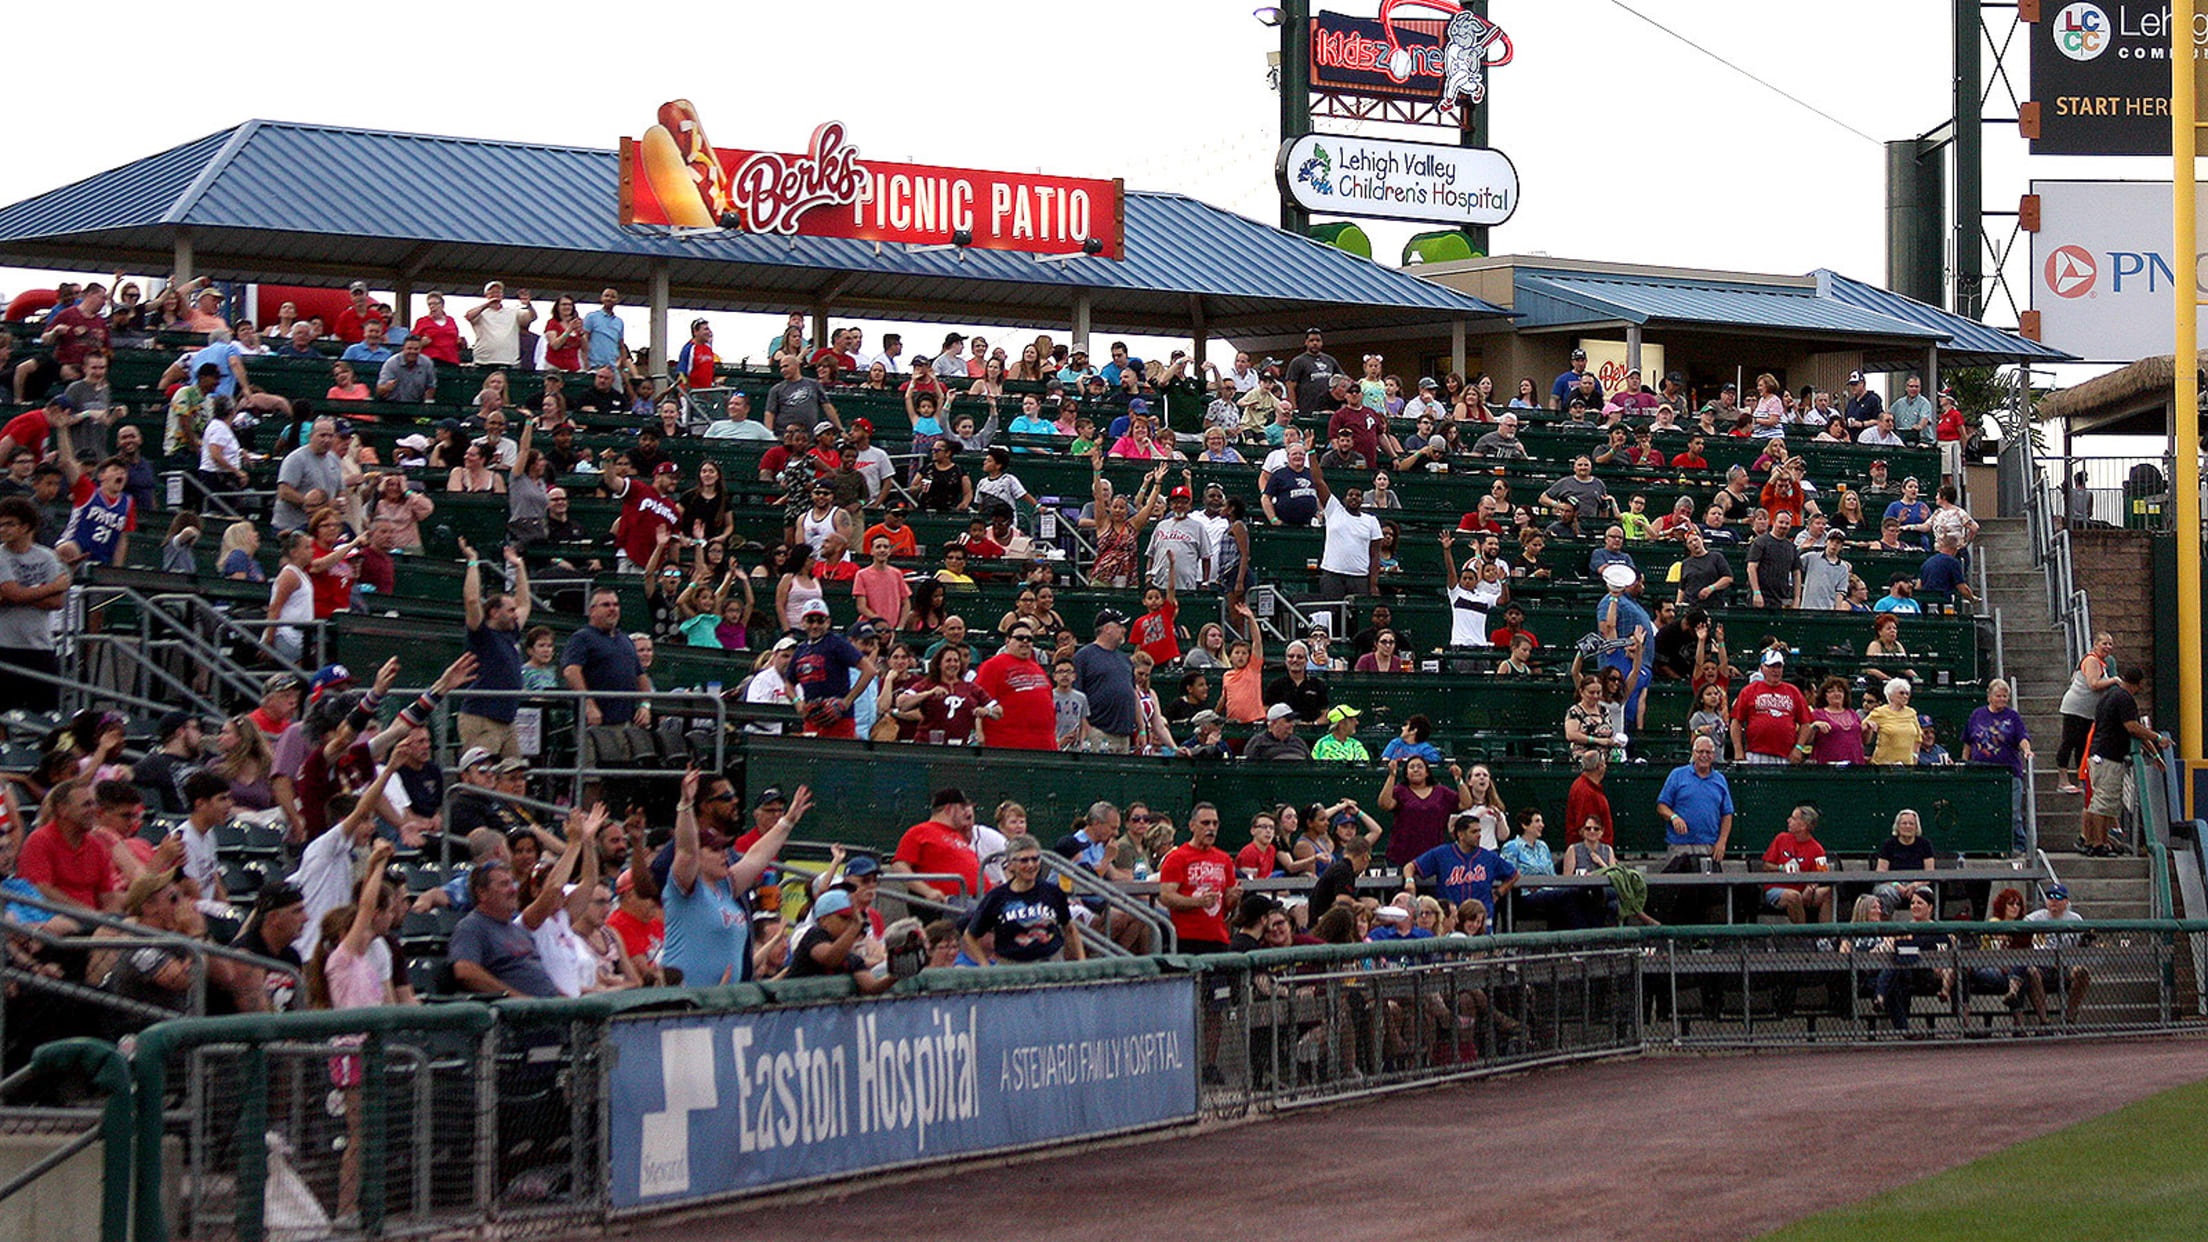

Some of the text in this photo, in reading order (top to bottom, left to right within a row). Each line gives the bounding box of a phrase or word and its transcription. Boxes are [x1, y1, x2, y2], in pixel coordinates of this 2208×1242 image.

[2120, 5, 2208, 45] Lehg
[2118, 47, 2208, 59] COM
[2056, 96, 2173, 116] START HER
[1339, 147, 1456, 185] Lehigh Valley
[854, 173, 974, 235] PICNIC
[992, 182, 1090, 243] PATIO
[1339, 175, 1508, 214] Children's Hospital
[1599, 360, 1629, 392] Ber
[944, 695, 966, 719] P
[1445, 864, 1487, 887] Mets
[732, 1005, 980, 1153] Easton Hospital
[1000, 1049, 1011, 1092] A
